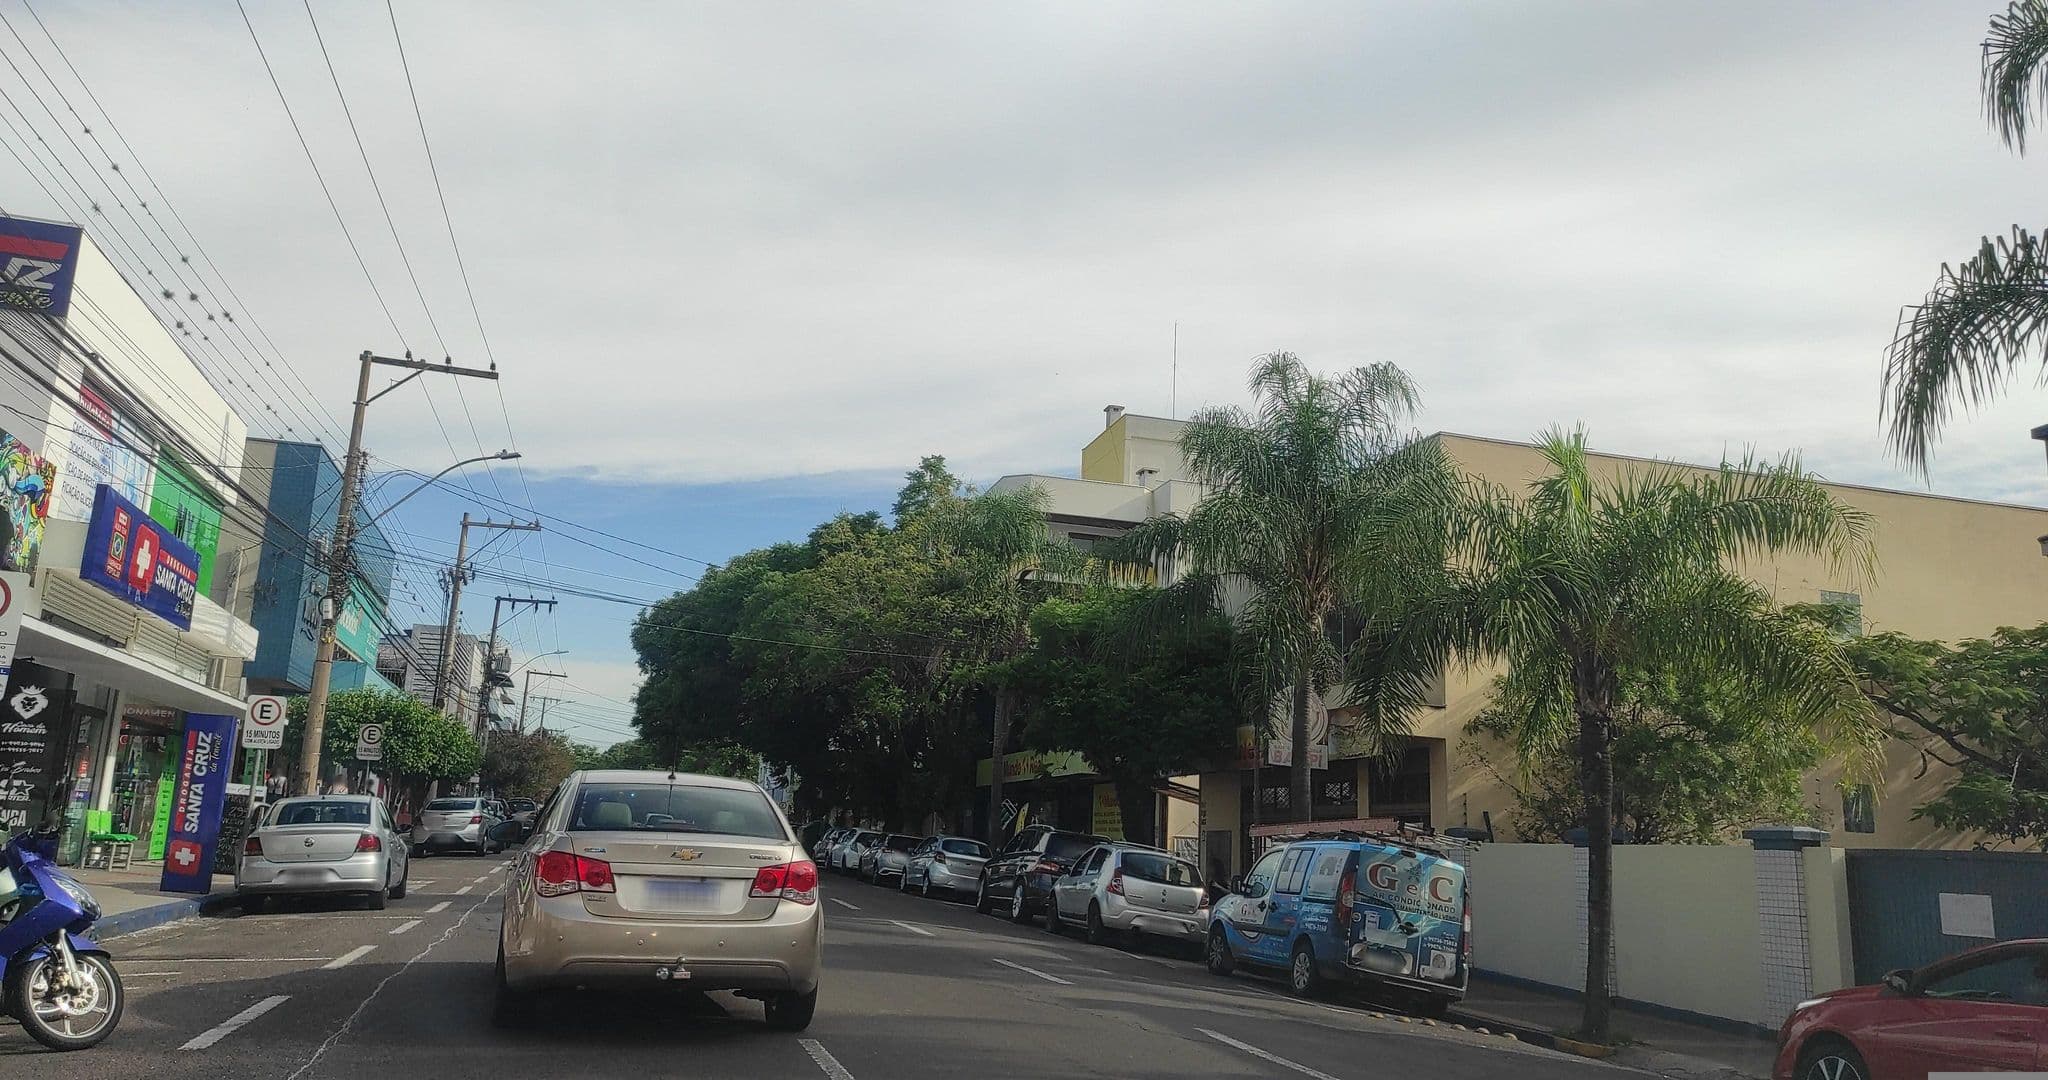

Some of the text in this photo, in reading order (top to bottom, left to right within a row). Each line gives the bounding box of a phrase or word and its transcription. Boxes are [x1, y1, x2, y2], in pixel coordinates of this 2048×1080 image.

[155, 565, 195, 605] SANTA CRUZ
[260, 704, 272, 719] E
[246, 730, 280, 740] 15 MINUTOS
[368, 730, 377, 740] E
[178, 748, 195, 813] DROGARIA
[184, 731, 212, 834] SANTA CRUZ
[1367, 862, 1398, 892] G
[1407, 884, 1418, 896] e
[1429, 876, 1454, 904] C
[1373, 891, 1385, 900] AR
[1388, 894, 1456, 914] CONDICONADO
